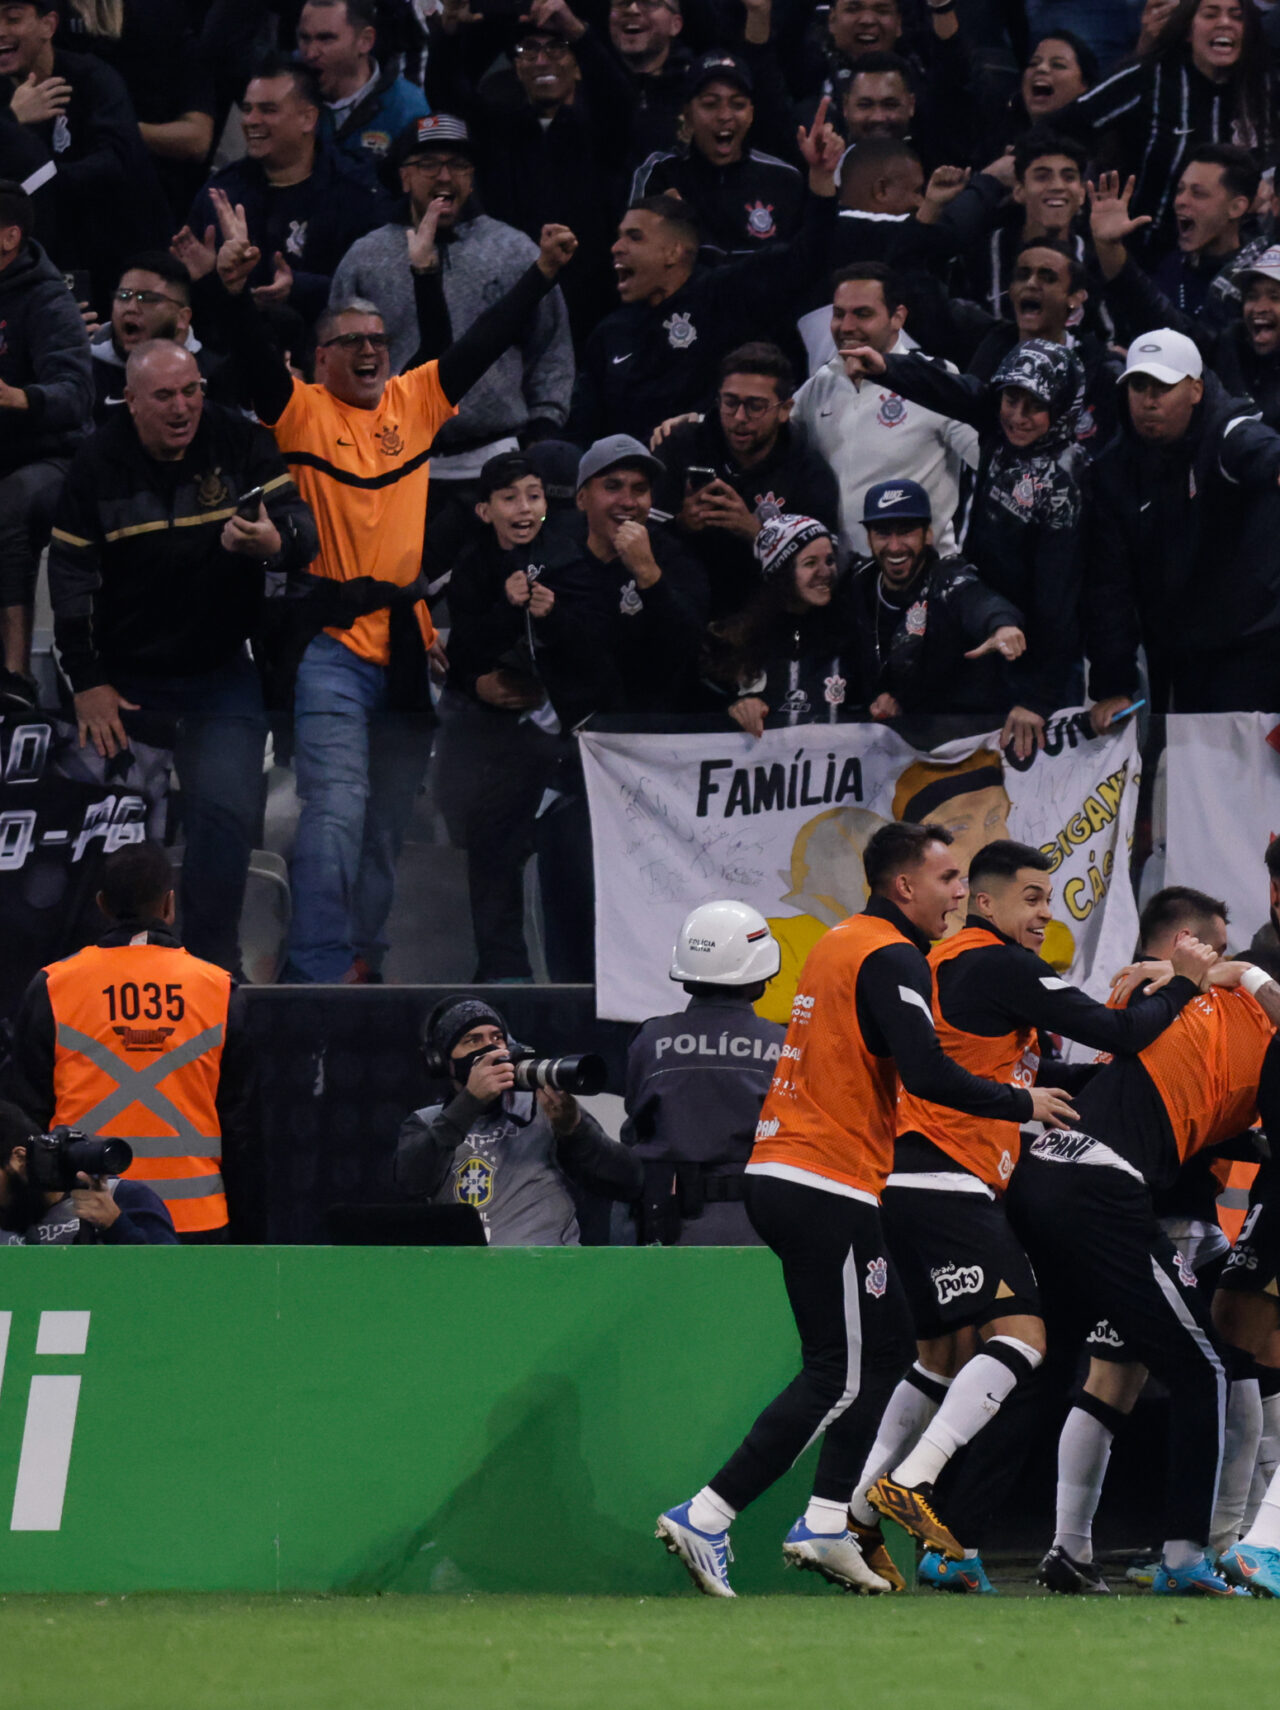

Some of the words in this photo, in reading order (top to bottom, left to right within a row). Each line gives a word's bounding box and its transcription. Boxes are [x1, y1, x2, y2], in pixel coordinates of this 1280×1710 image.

[102, 982, 185, 1021] 1035
[656, 1030, 781, 1062] POLÍCIA
[937, 1267, 982, 1302] Poty
[0, 1311, 91, 1531] i
